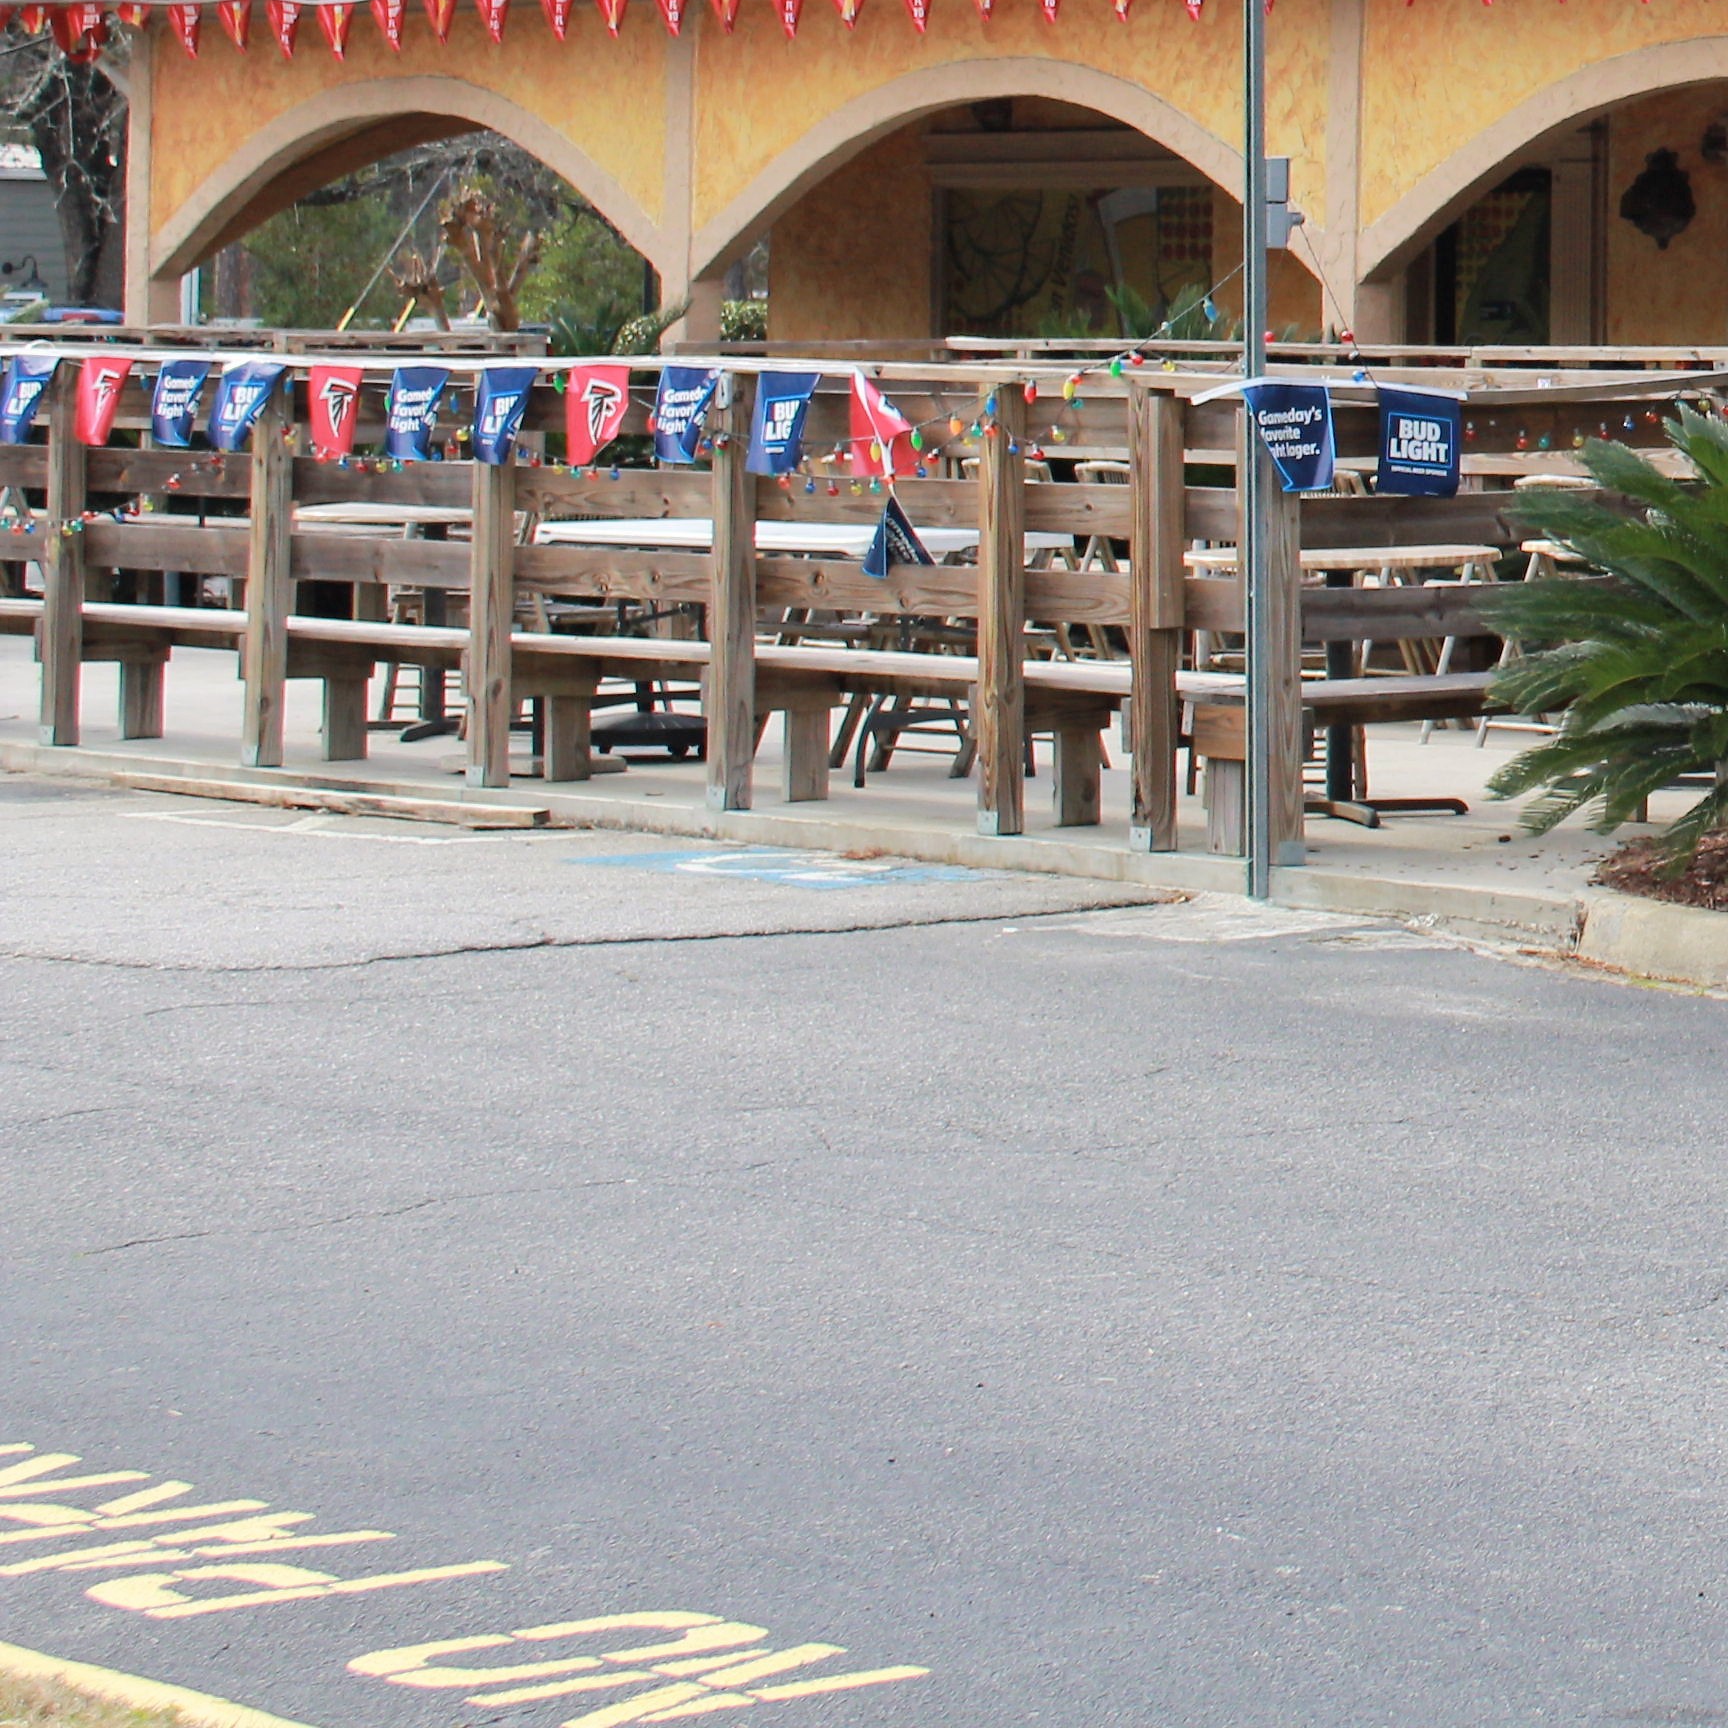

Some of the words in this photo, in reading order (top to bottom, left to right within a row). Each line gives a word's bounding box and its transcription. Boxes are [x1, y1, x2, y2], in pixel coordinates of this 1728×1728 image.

[1258, 405, 1322, 426] Gameday's
[1398, 418, 1441, 442] BUD
[1286, 442, 1320, 460] lager.
[1390, 437, 1449, 463] LIGHT
